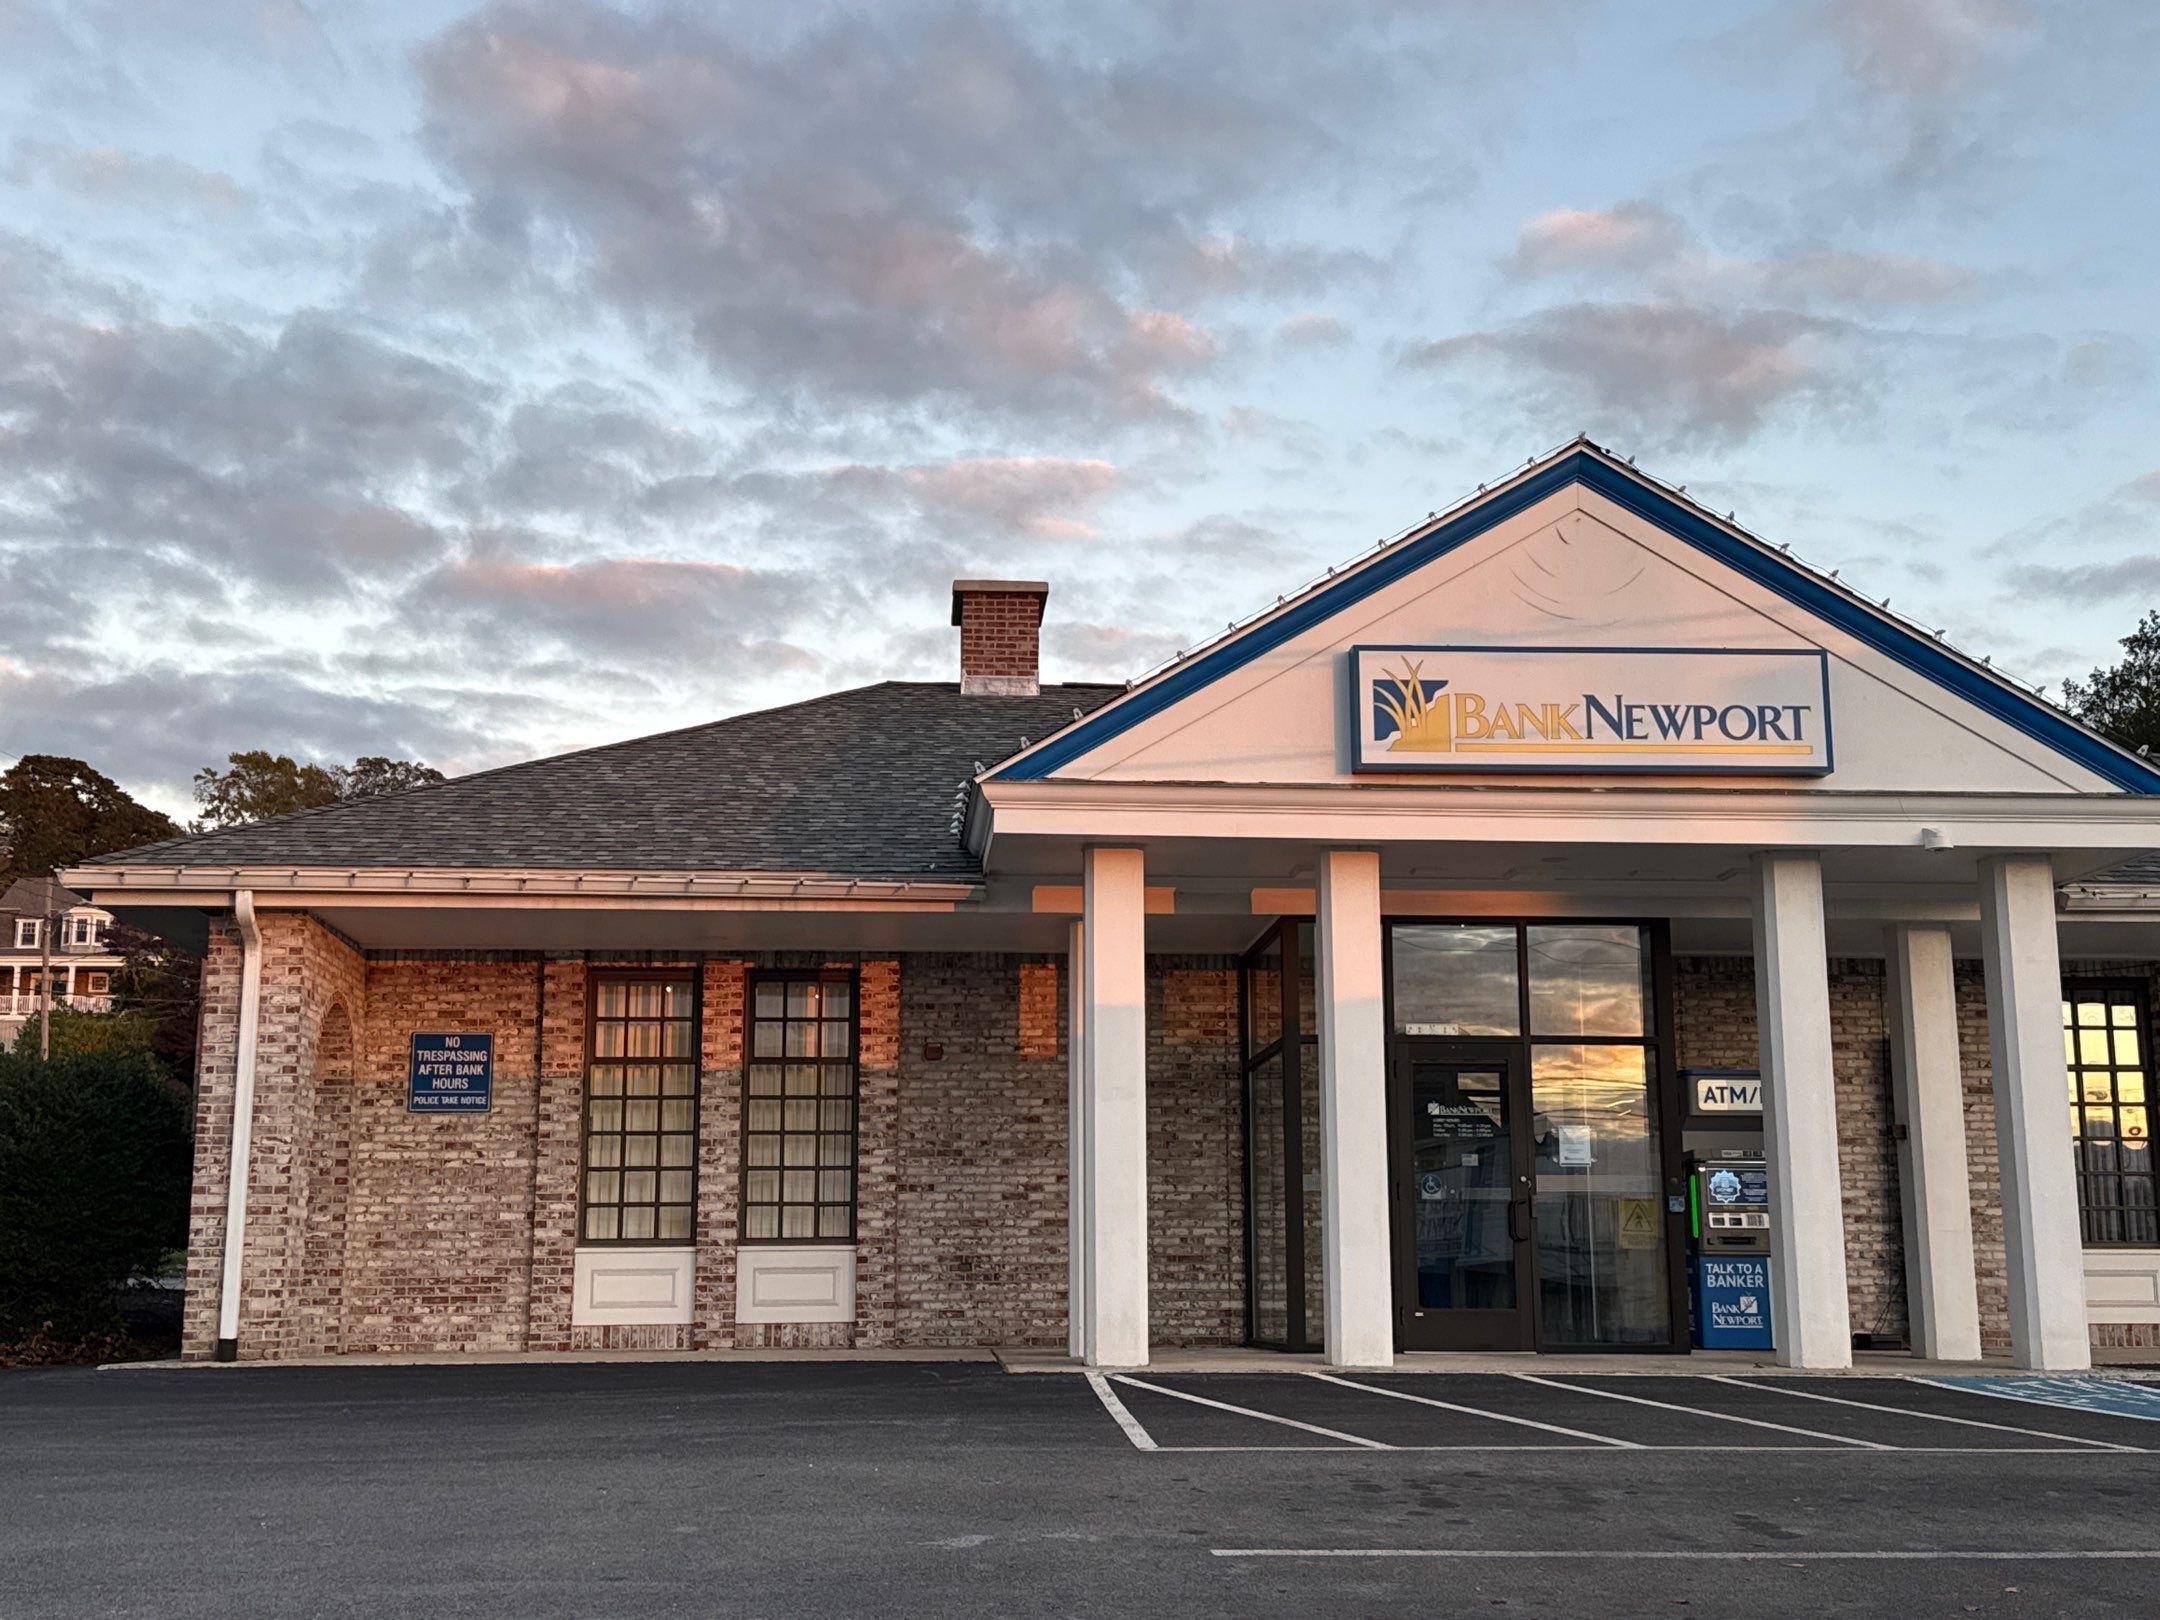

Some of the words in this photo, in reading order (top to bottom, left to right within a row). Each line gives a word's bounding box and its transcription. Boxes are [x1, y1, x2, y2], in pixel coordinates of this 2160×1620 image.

[445, 1036, 461, 1048] NO
[417, 1050, 488, 1062] TRESPASSING
[418, 1064, 453, 1076] AFTER
[455, 1064, 484, 1076] BANK
[432, 1078, 469, 1089] HOURS
[413, 1096, 439, 1105] POLICE
[441, 1096, 459, 1105] TAKE
[460, 1096, 487, 1105] NOTICE
[1705, 1263, 1735, 1274] TALK
[1736, 1263, 1752, 1275] TO
[1754, 1264, 1763, 1274] A
[1706, 1275, 1765, 1288] BANKER
[1712, 1301, 1740, 1314] BANK
[1712, 1314, 1764, 1326] NEWPORT
